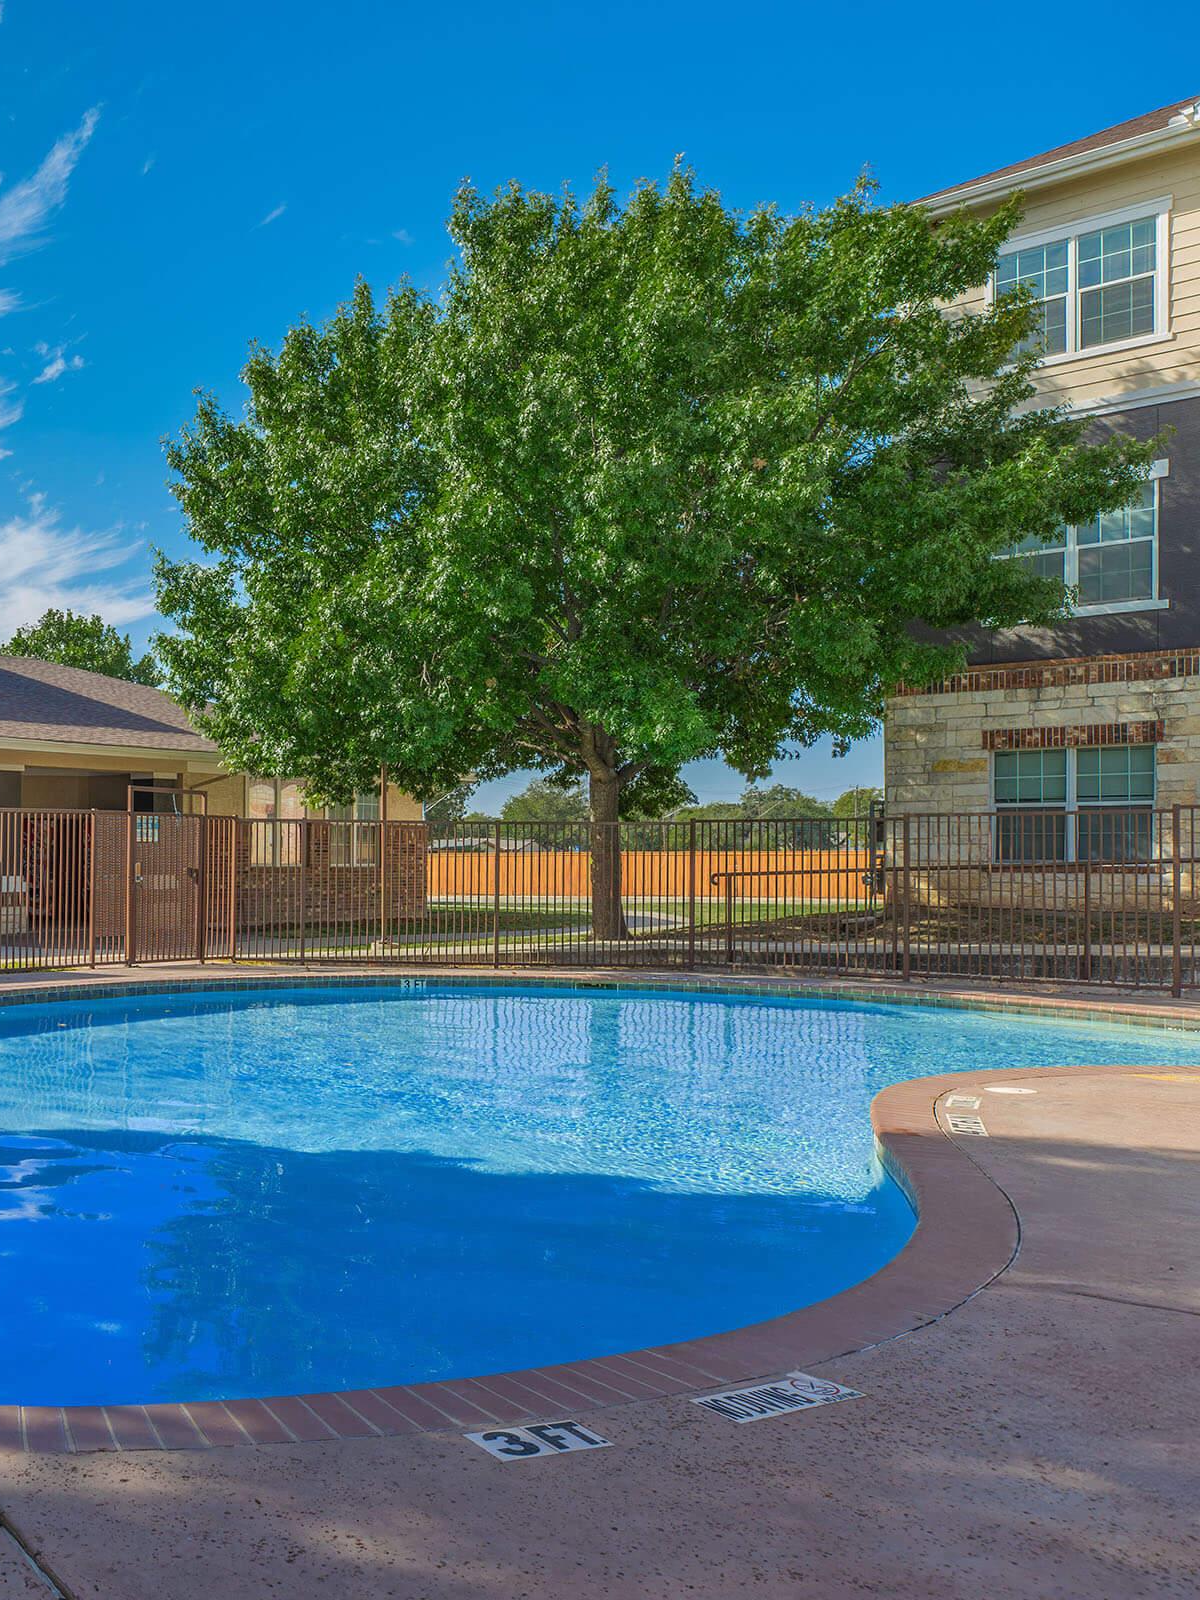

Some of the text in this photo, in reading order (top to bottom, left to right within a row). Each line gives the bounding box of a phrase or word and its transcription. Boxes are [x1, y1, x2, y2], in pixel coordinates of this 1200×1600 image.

[404, 979, 410, 988] 3
[697, 1386, 817, 1421] NO DIVING
[482, 1421, 609, 1457] 3 FT.
